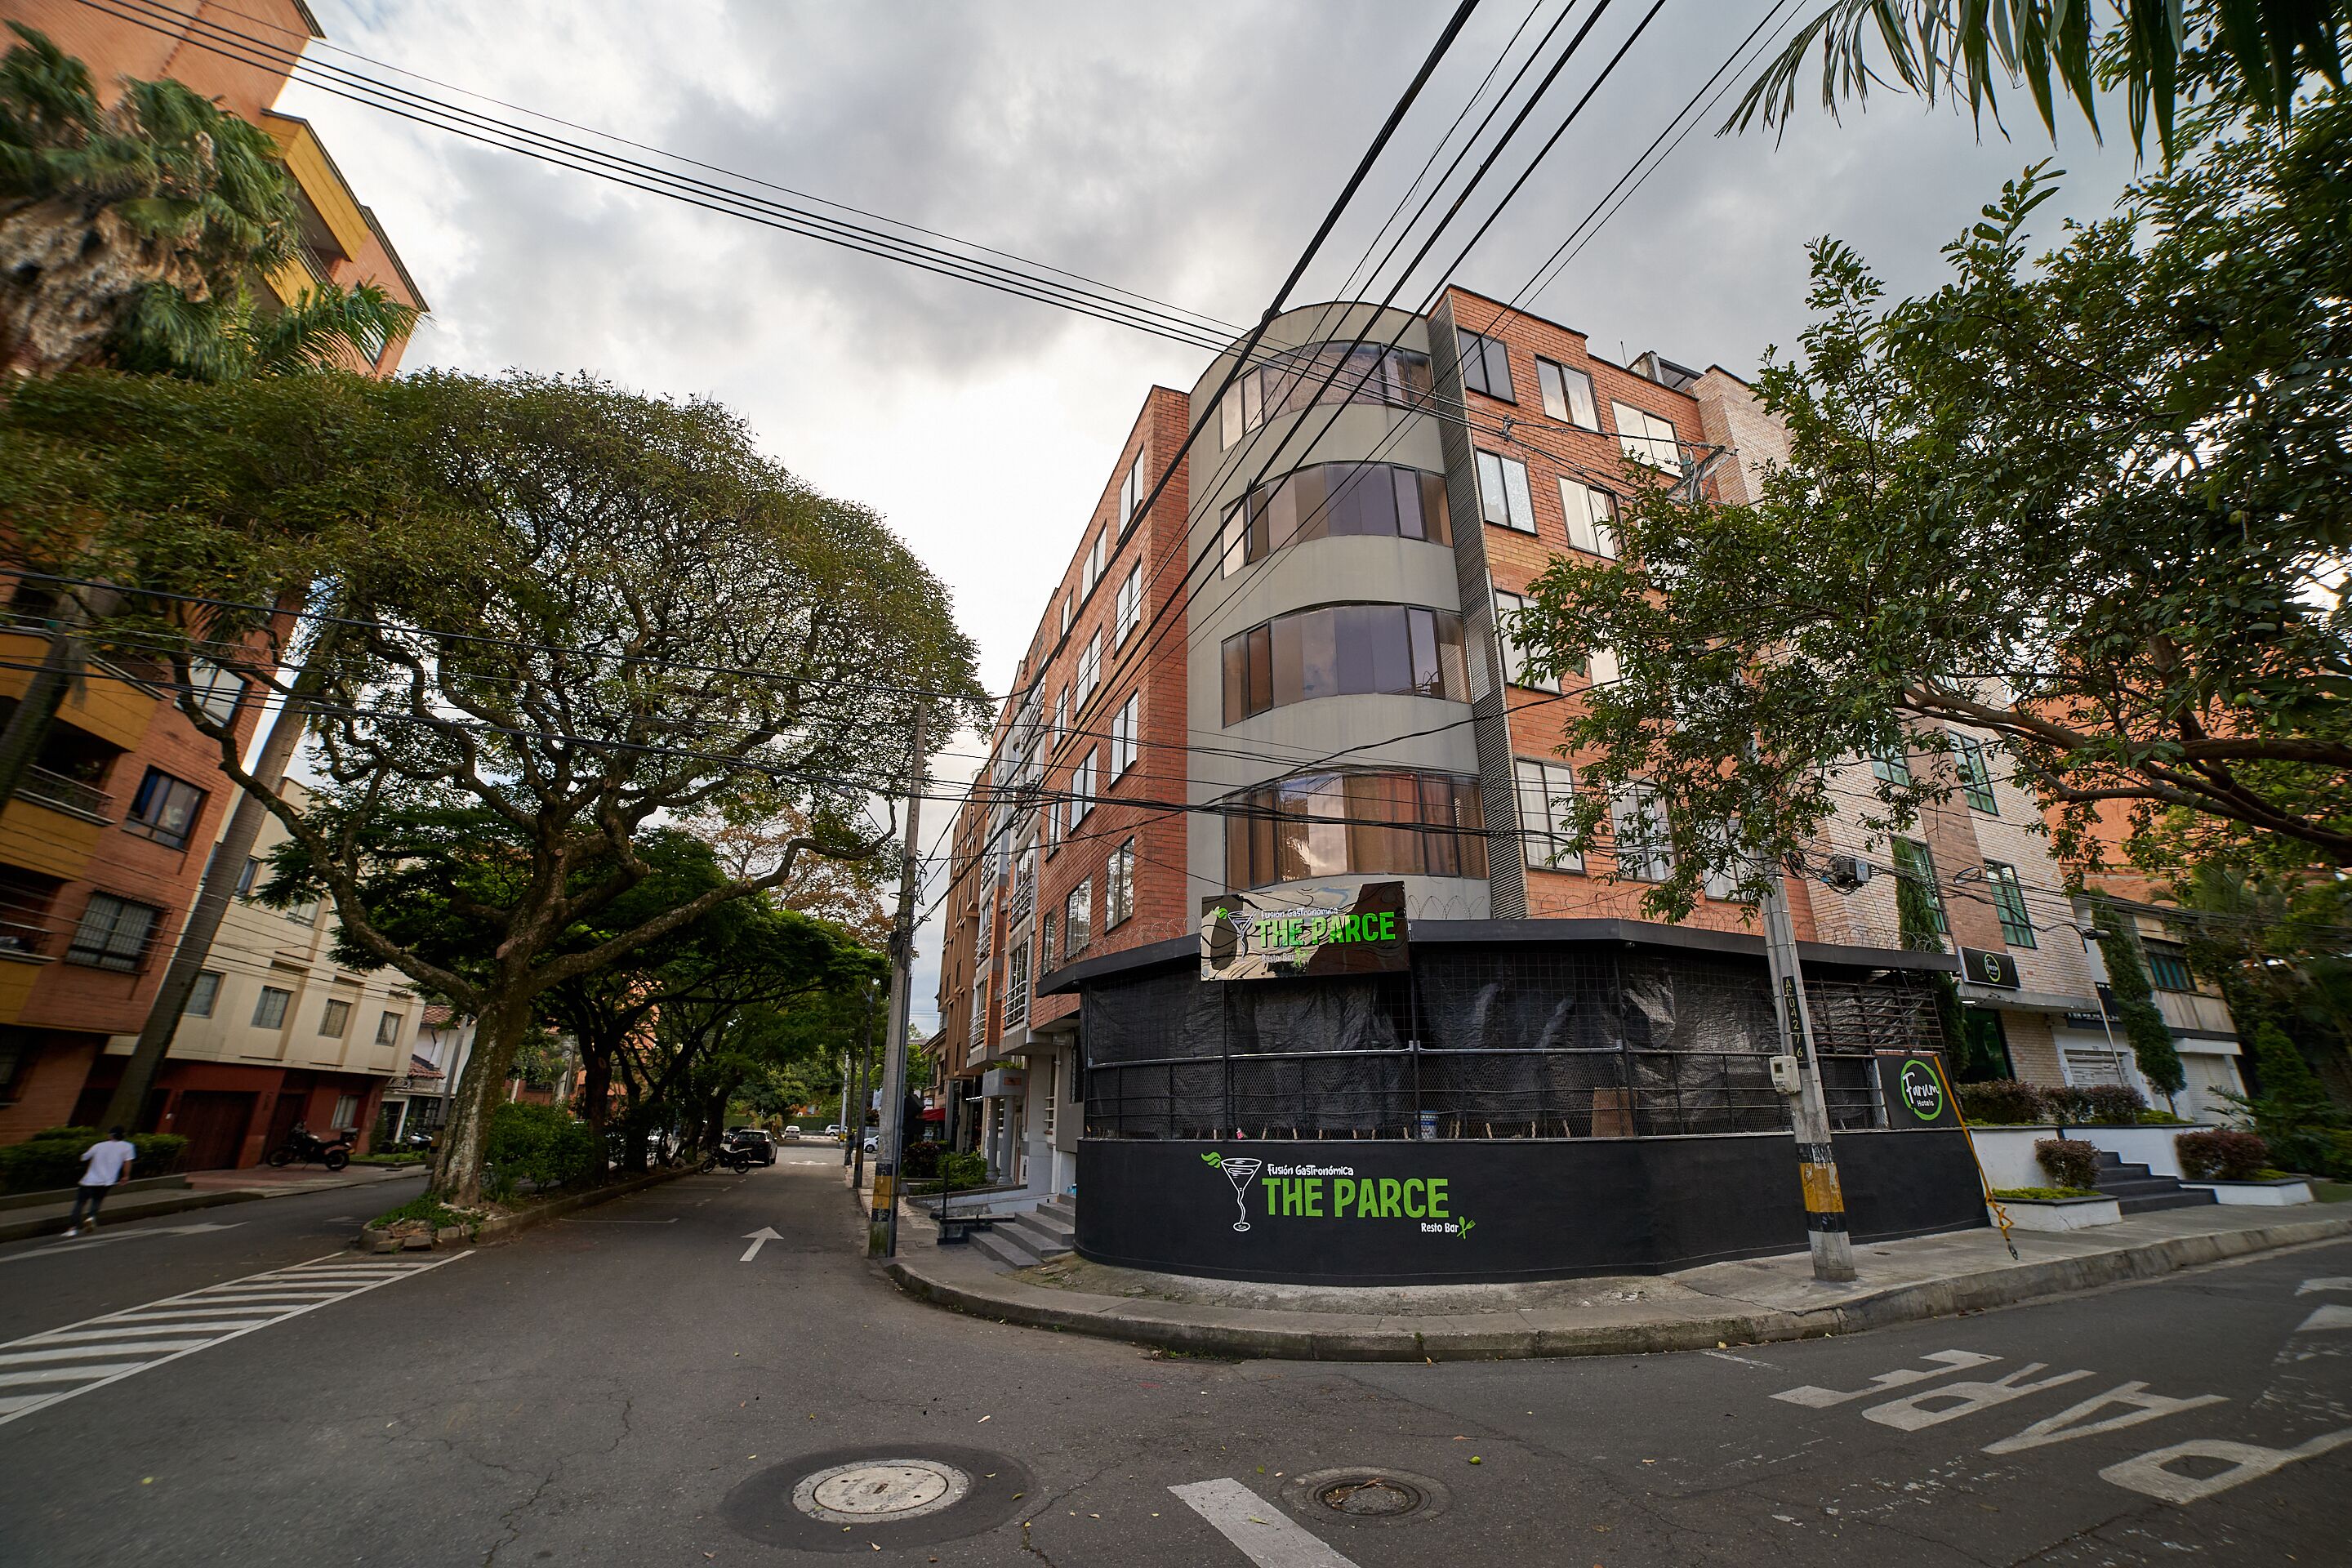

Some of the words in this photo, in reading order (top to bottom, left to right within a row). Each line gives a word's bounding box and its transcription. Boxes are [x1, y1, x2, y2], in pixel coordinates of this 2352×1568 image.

[1254, 918, 1304, 948] THE
[1311, 911, 1396, 946] PARCE
[1261, 953, 1280, 962] Resto
[1282, 952, 1294, 961] Bar
[1902, 1071, 1940, 1104] Farum
[1916, 1099, 1935, 1107] Hotels
[1267, 1163, 1294, 1177] Fusión
[1262, 1178, 1323, 1217] THE
[1334, 1178, 1450, 1218] PARCE
[1421, 1222, 1443, 1232] Resto
[1444, 1223, 1459, 1233] Bar
[1768, 1349, 2352, 1504] PARE
